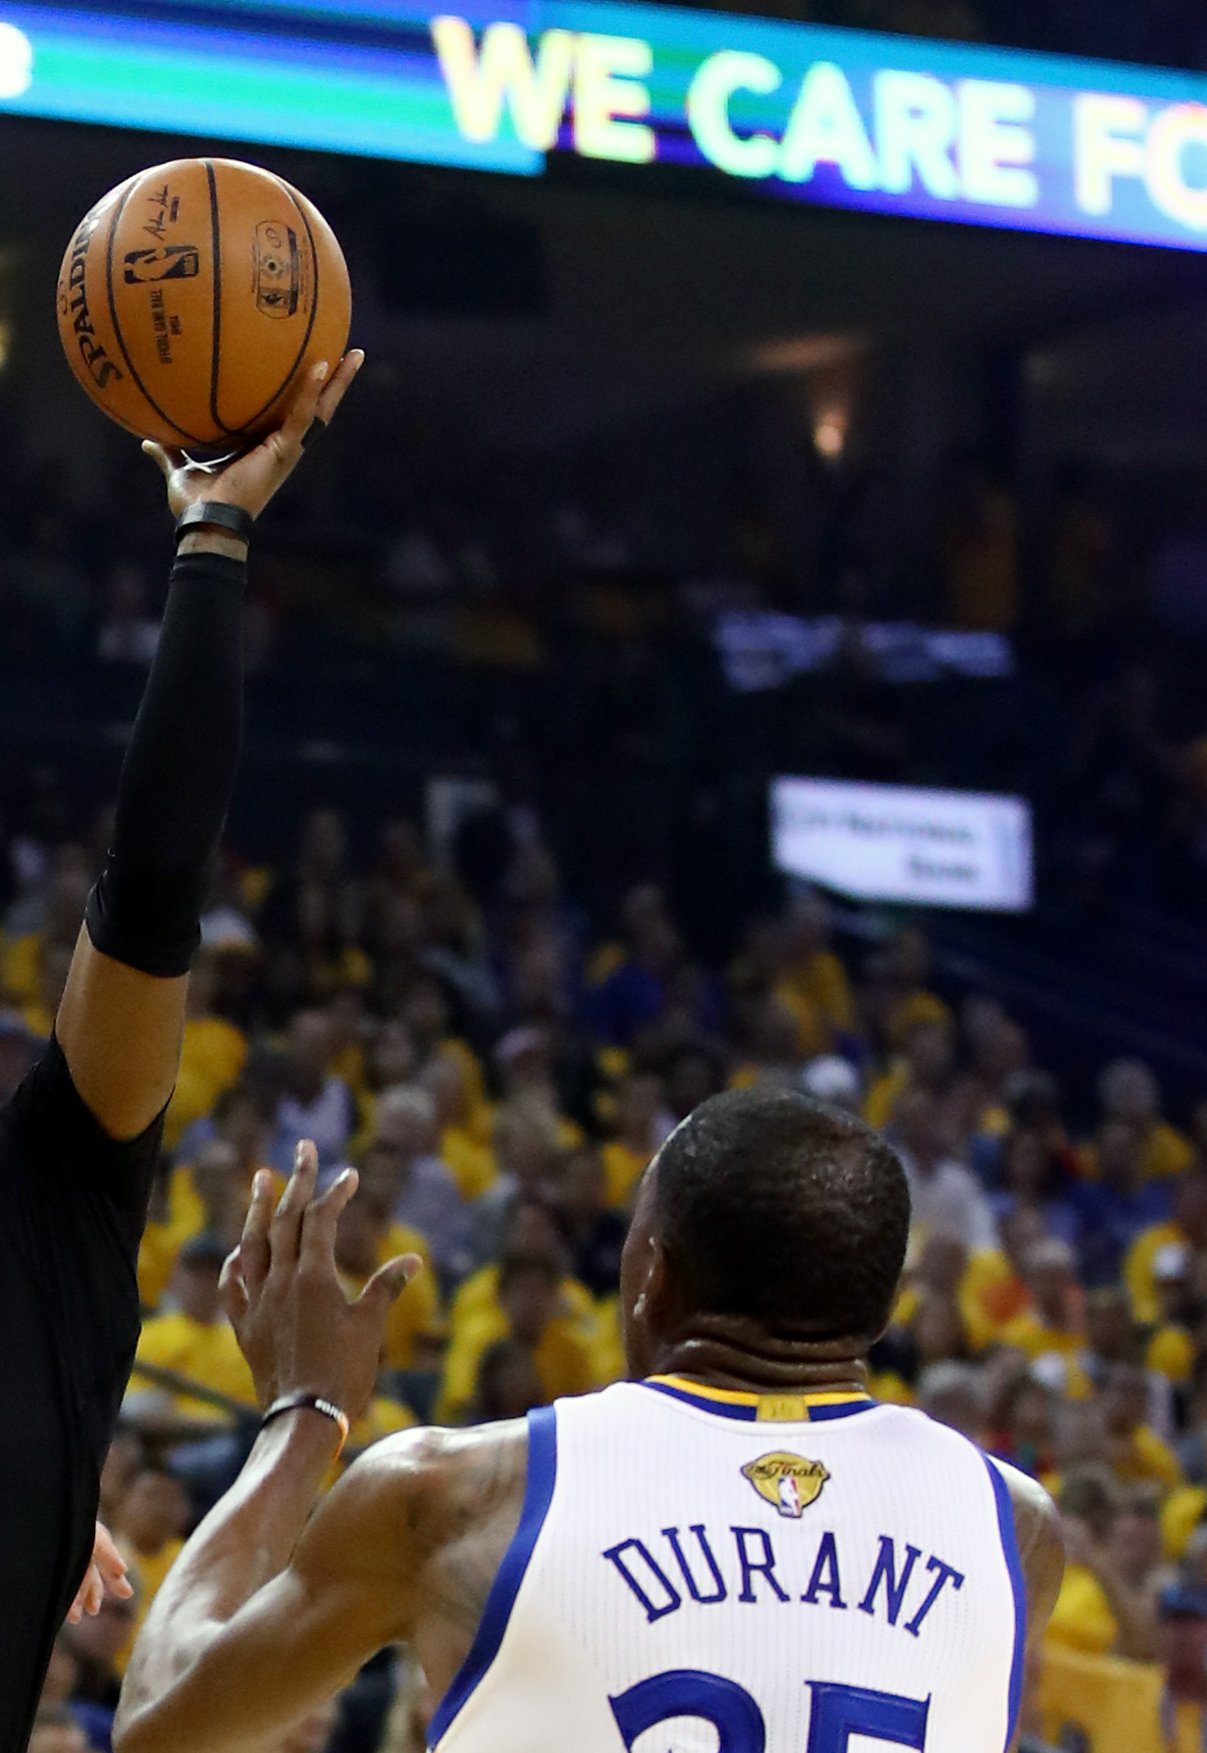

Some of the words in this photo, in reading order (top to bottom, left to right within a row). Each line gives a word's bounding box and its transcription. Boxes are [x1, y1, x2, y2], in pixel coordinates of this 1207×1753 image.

[430, 15, 658, 164] WE
[686, 50, 1040, 208] CARE
[1073, 92, 1207, 236] FO
[602, 1524, 966, 1638] DURANT
